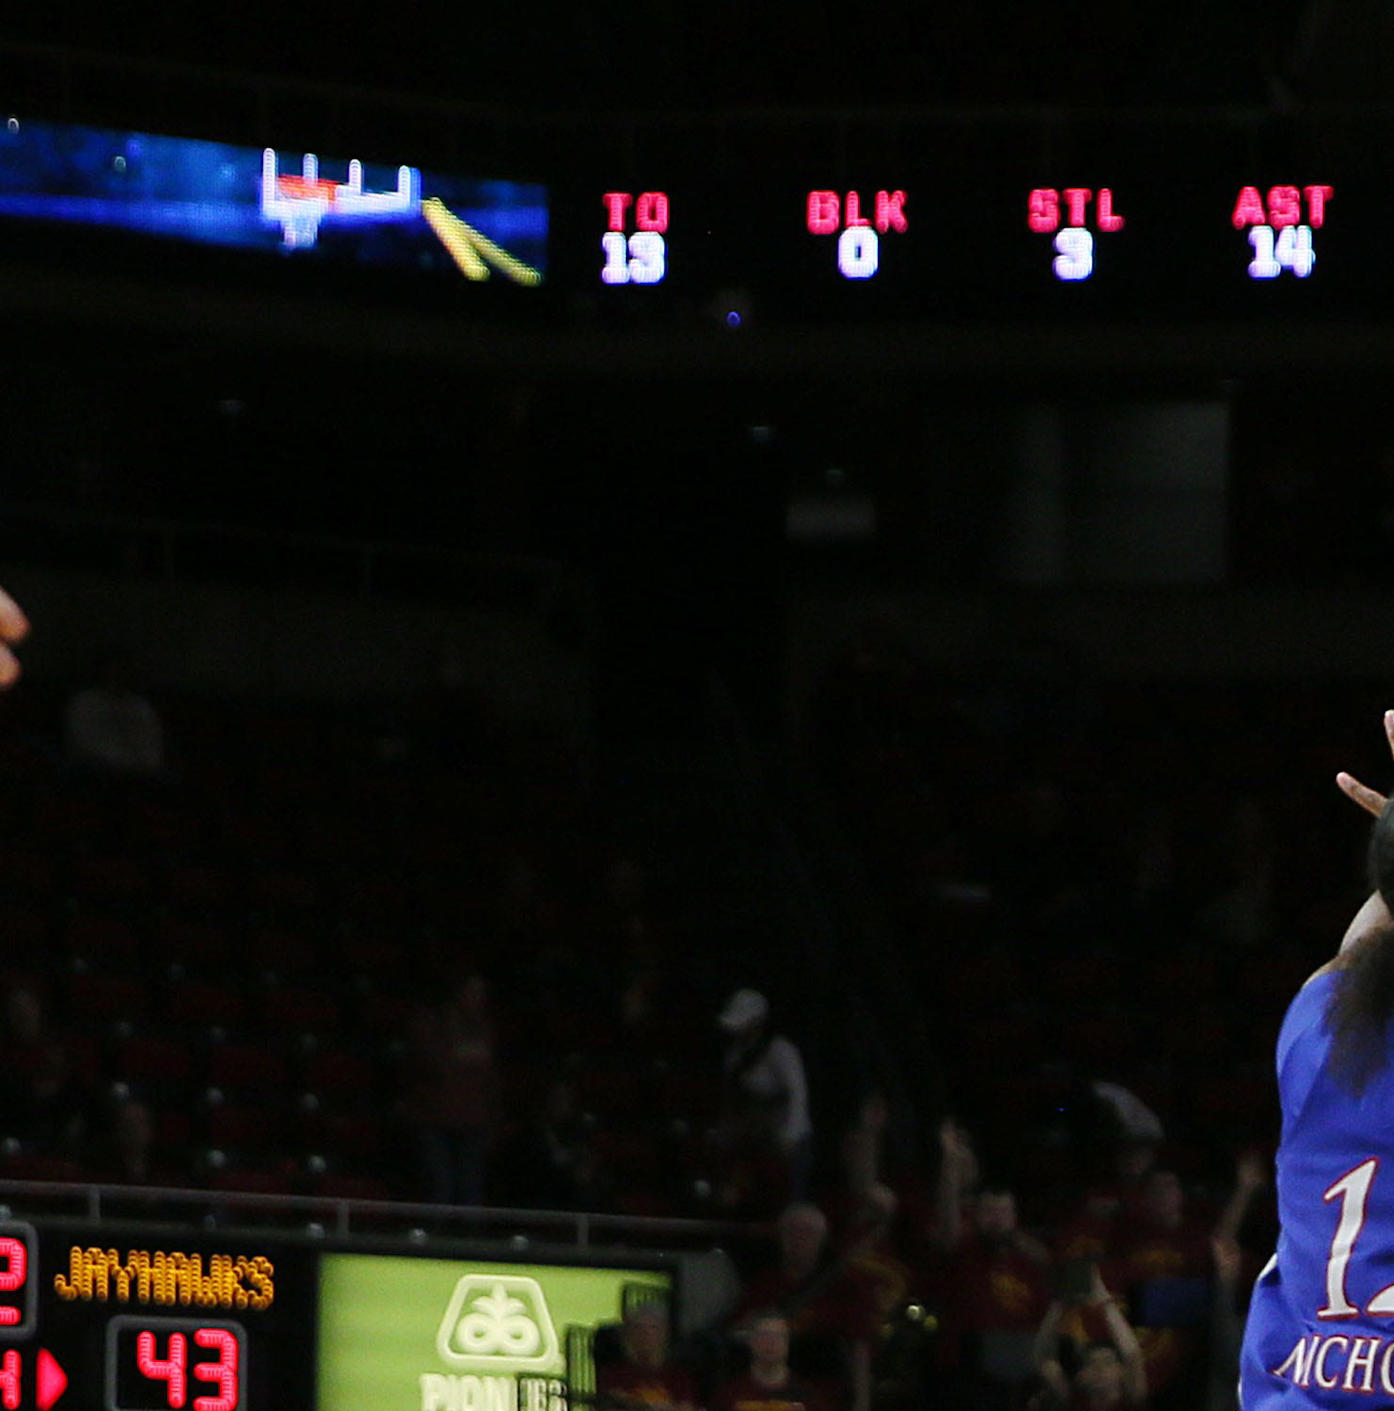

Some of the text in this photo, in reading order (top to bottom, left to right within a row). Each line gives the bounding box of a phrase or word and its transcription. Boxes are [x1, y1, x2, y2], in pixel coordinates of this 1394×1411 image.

[604, 191, 669, 233] TO
[807, 189, 908, 235] BLK
[1029, 188, 1124, 234] STL
[1232, 185, 1334, 229] AST
[1247, 226, 1315, 280] 14
